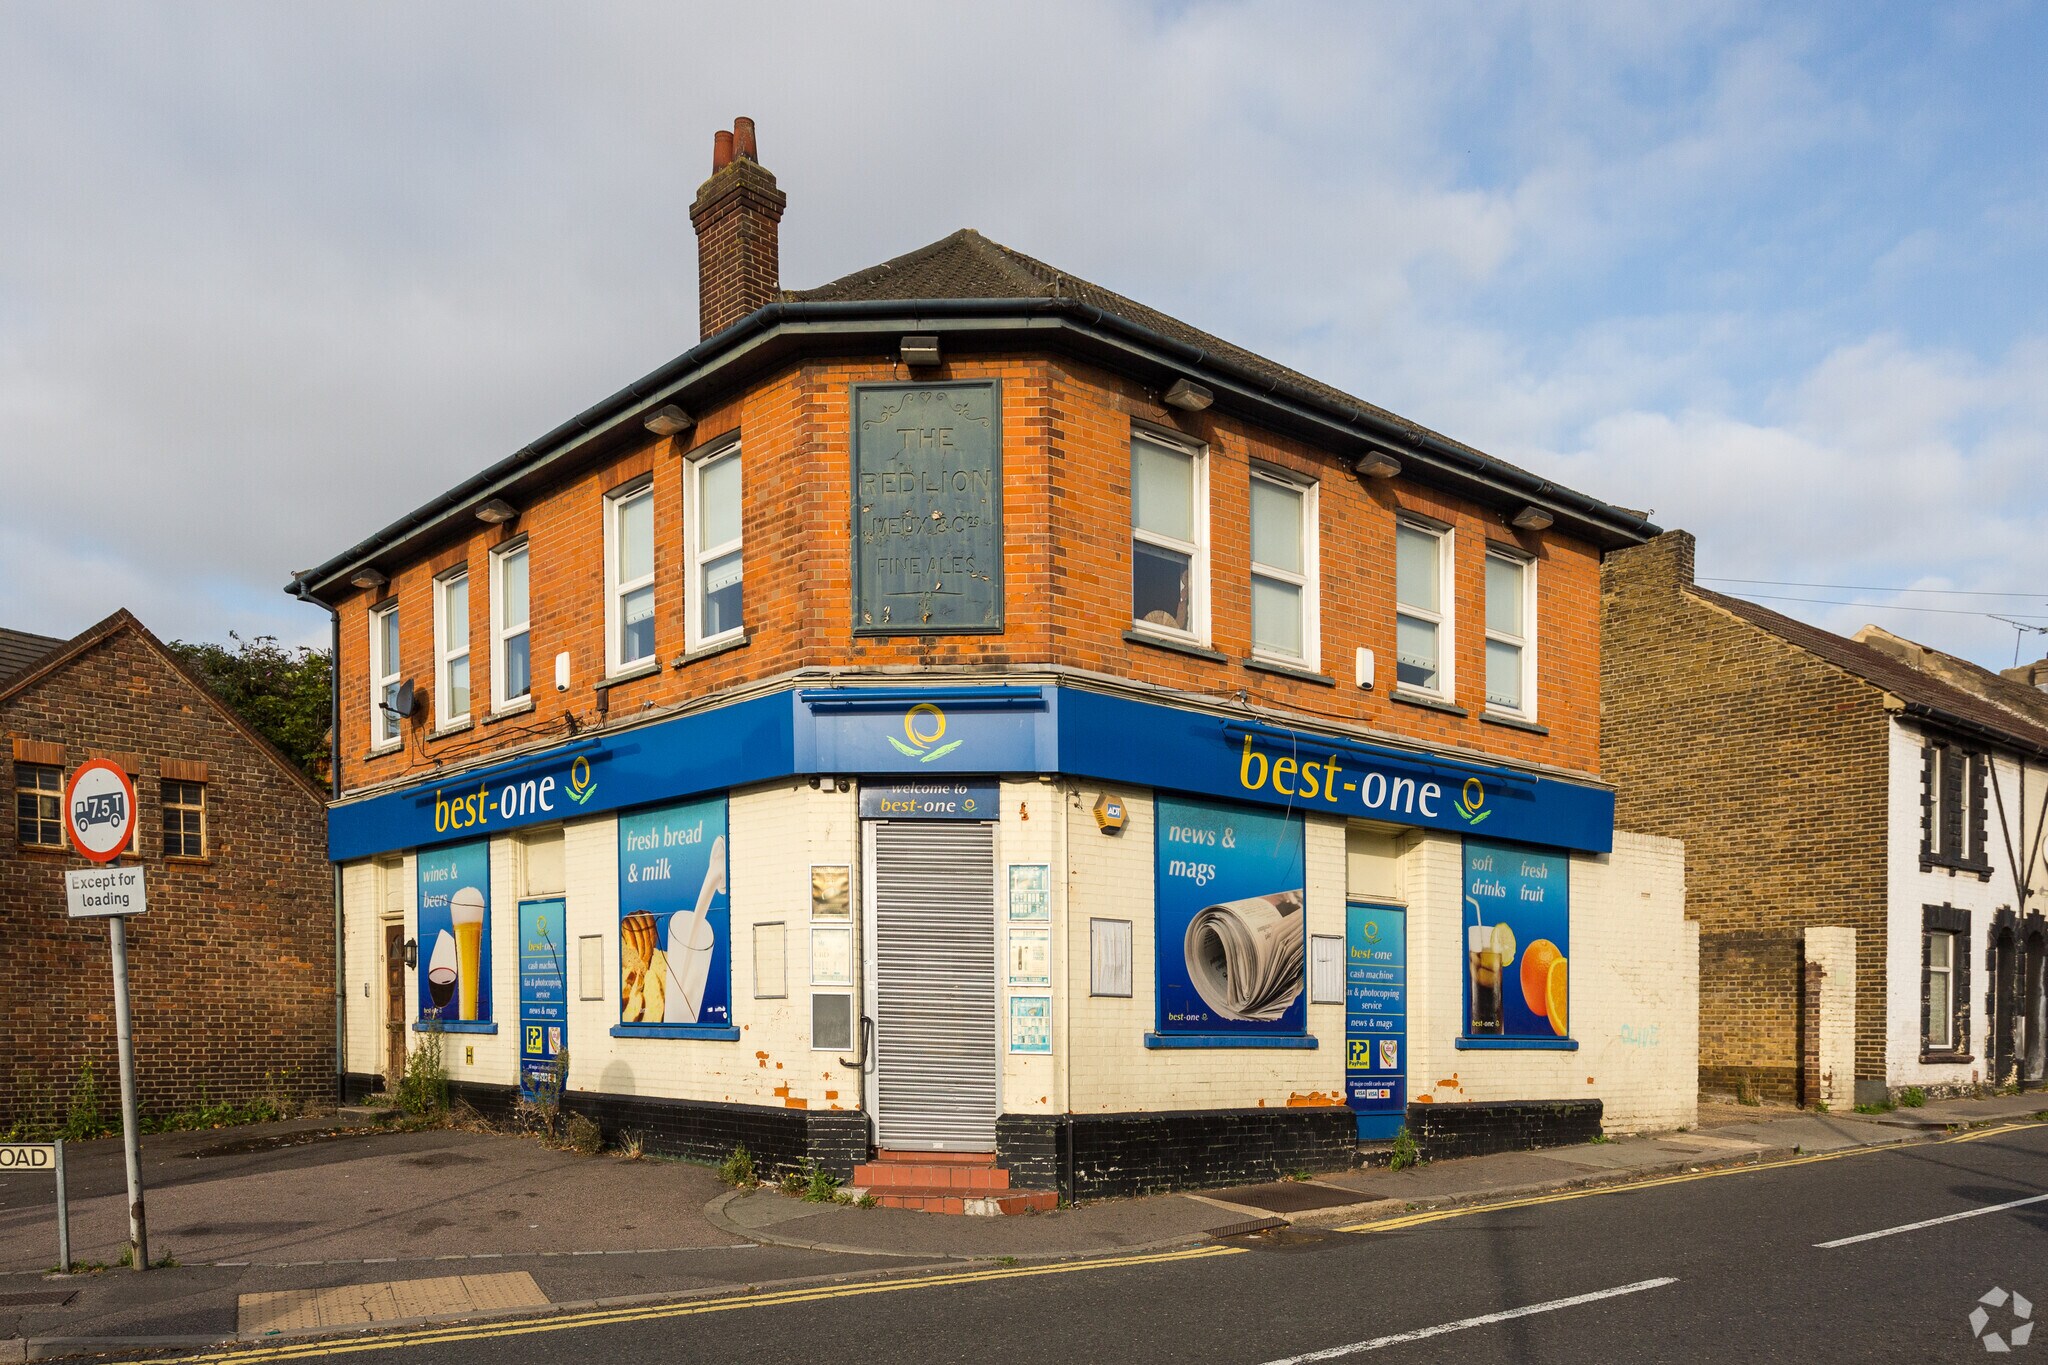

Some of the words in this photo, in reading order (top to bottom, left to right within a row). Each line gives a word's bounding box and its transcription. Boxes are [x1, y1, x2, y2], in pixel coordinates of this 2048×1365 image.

[896, 428, 954, 449] THE
[859, 472, 916, 495] RED
[920, 470, 992, 494] LION
[877, 557, 921, 575] FINE
[1240, 734, 1441, 818] best-one
[891, 781, 950, 795] welcome
[954, 783, 968, 795] to
[88, 798, 111, 819] 7.5
[112, 794, 121, 811] T
[434, 776, 555, 833] best-one
[880, 798, 956, 813] best-one
[1107, 806, 1120, 816] ADT
[627, 827, 659, 852] fresh
[663, 819, 703, 848] bread
[1168, 825, 1216, 846] news
[1221, 827, 1236, 849] &
[627, 862, 638, 883] &
[642, 857, 672, 882] milk
[1471, 855, 1493, 872] soft
[1520, 860, 1548, 880] fresh
[423, 865, 448, 883] wines
[450, 862, 458, 880] &
[1168, 859, 1216, 887] mags
[72, 874, 116, 891] Except
[118, 872, 136, 887] for
[1471, 877, 1506, 898] drinks
[82, 892, 129, 907] loading
[423, 891, 448, 908] beers
[1520, 884, 1544, 903] fruit
[1350, 945, 1393, 961] best-one
[528, 961, 538, 970] cash
[535, 977, 562, 989] photocopying
[1350, 969, 1364, 978] cash
[1365, 969, 1394, 980] machine
[536, 990, 550, 999] service
[1353, 987, 1359, 996] &
[1360, 987, 1399, 1001] photocopying
[529, 1007, 540, 1015] news
[541, 1006, 545, 1015] &
[545, 1007, 557, 1018] mags
[1361, 1000, 1382, 1010] service
[1168, 1012, 1200, 1022] best-one
[1350, 1019, 1367, 1027] news
[1369, 1018, 1374, 1027] &
[1376, 1020, 1393, 1030] mags
[1471, 1019, 1494, 1028] best-one
[0, 1148, 47, 1167] OAD
